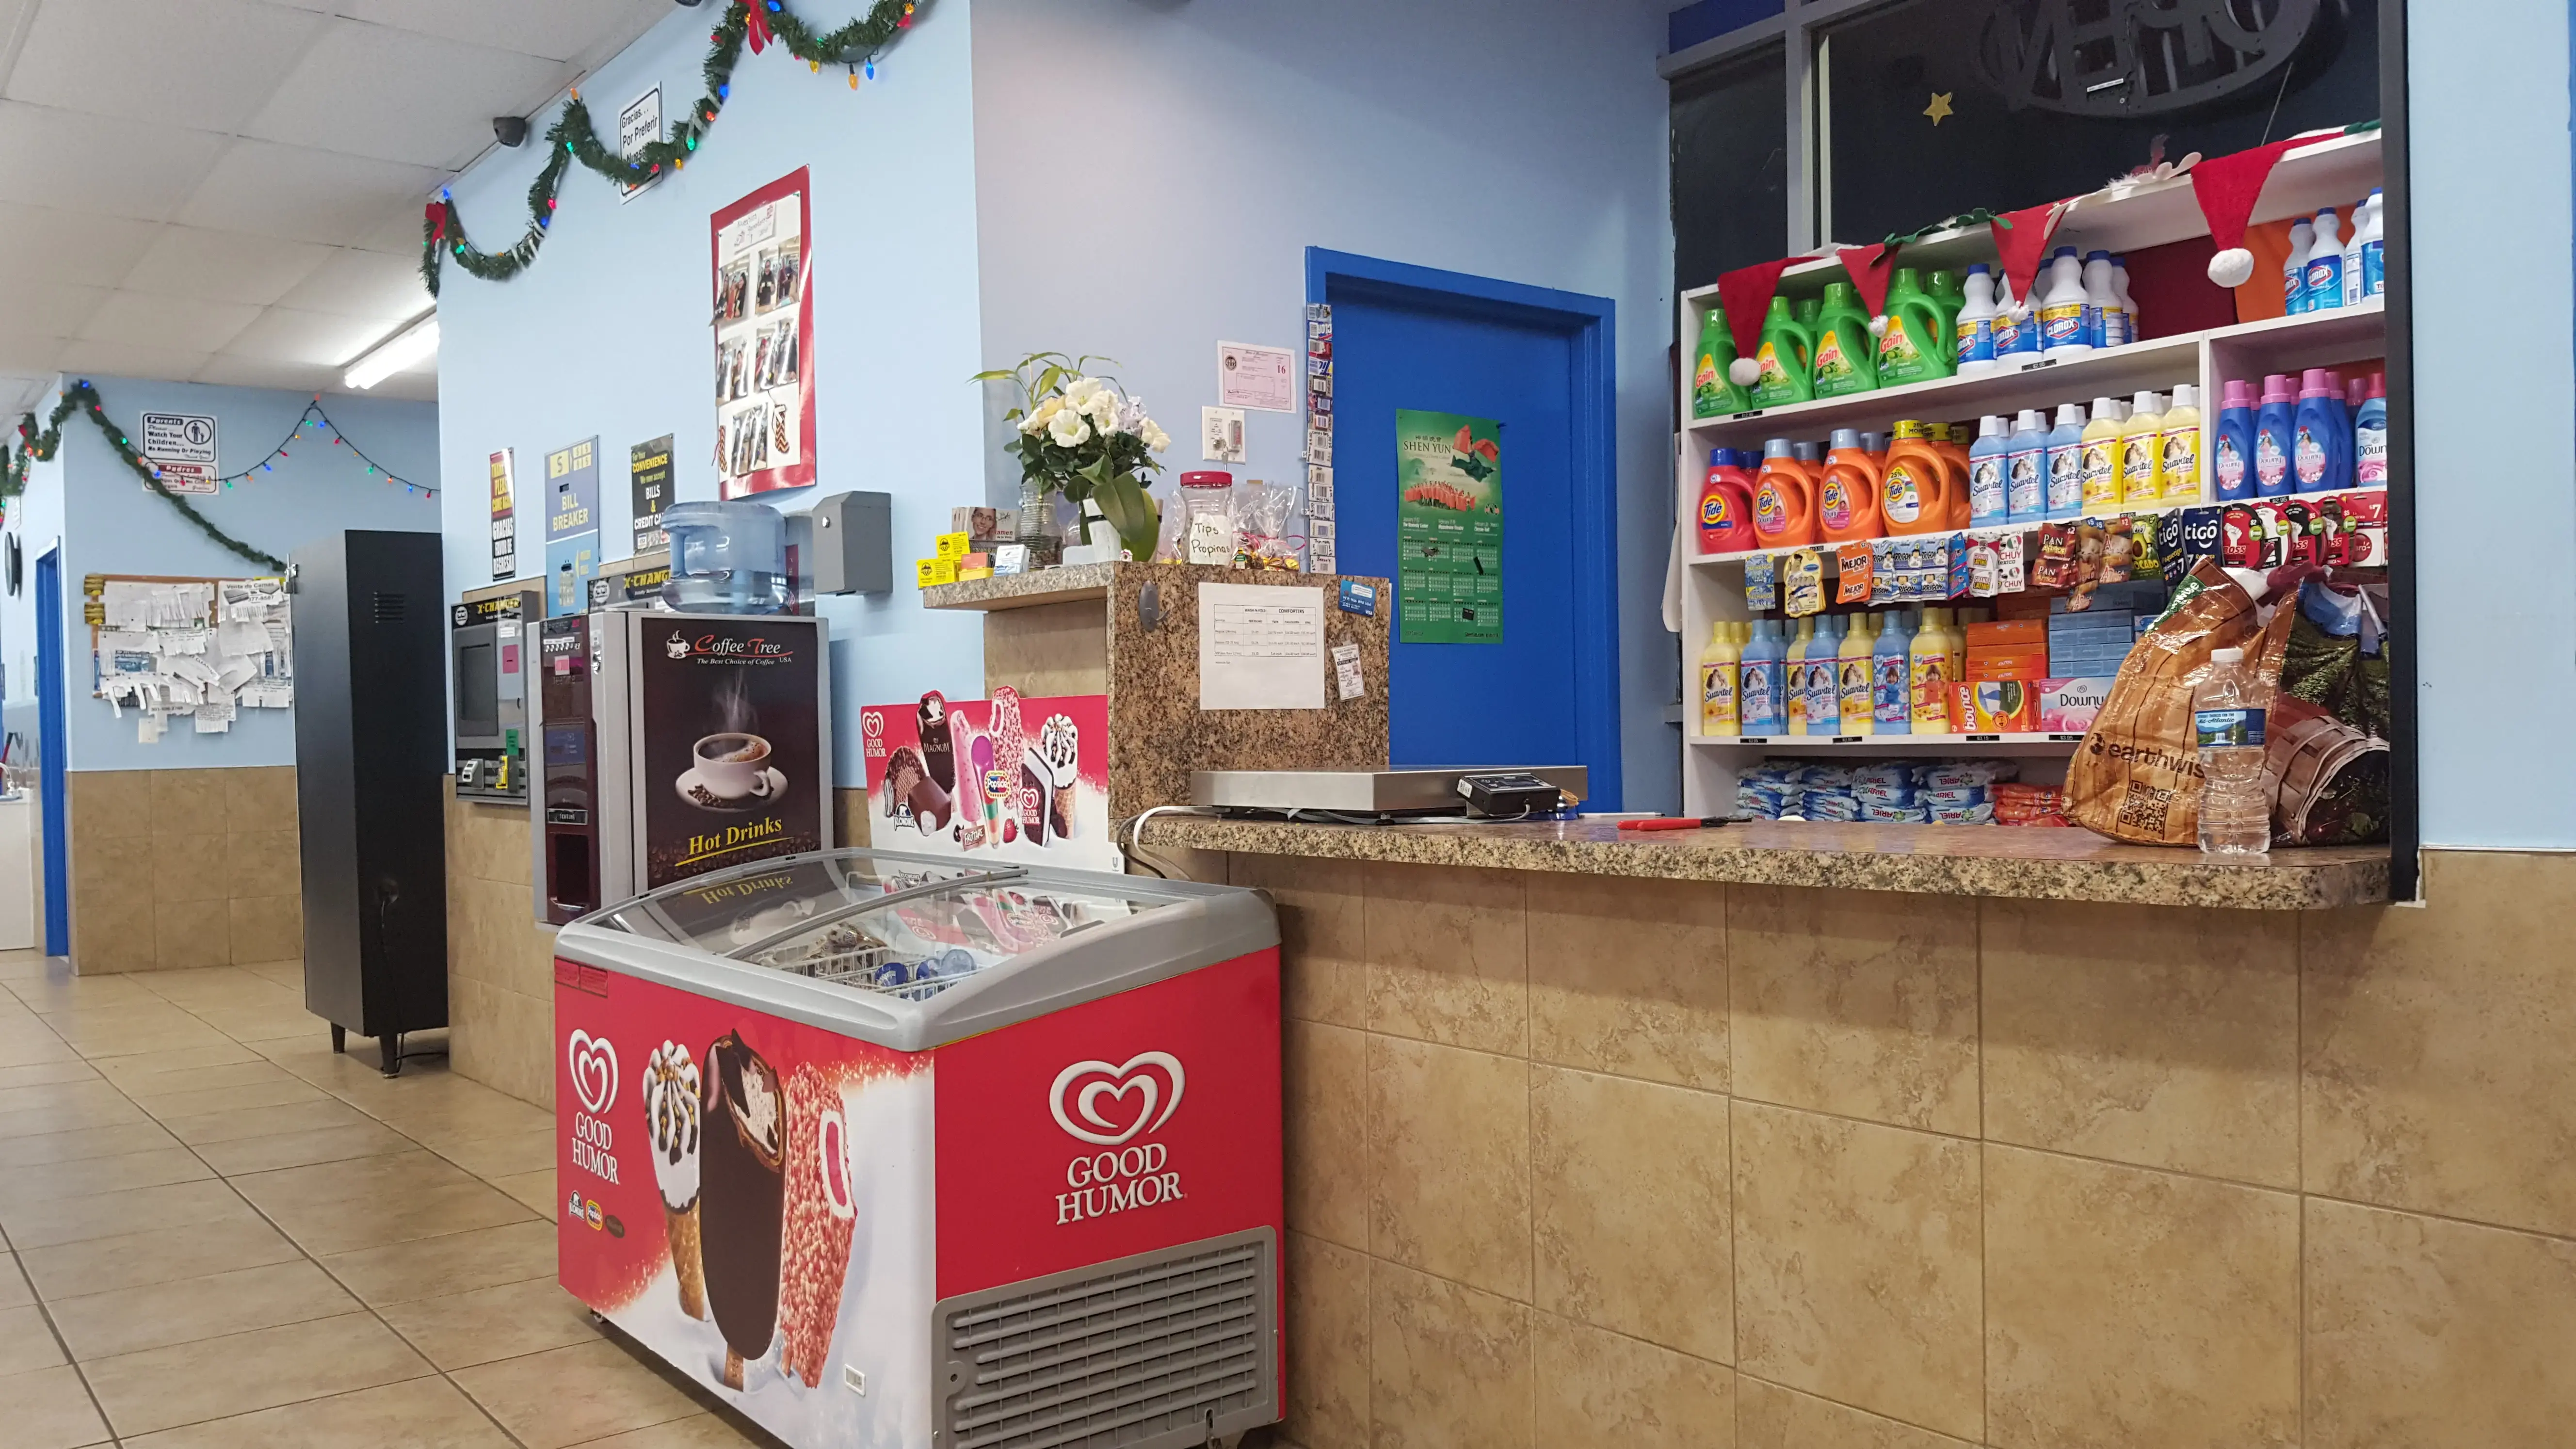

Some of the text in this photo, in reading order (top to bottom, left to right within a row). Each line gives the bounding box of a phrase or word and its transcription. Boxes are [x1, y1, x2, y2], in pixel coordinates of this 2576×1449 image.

[623, 115, 658, 149] Por Preferir
[2046, 318, 2076, 337] CLOROX
[1880, 334, 1903, 353] Gain
[1760, 359, 1775, 372] ain
[1817, 349, 1838, 368] Gain
[1277, 364, 1286, 375] 16
[1695, 370, 1714, 388] Gain
[1403, 441, 1451, 454] SHEN YUN
[632, 453, 668, 474] CONVENIENCE
[2162, 454, 2194, 473] Suavitel
[2297, 453, 2322, 462] Downy
[2082, 464, 2112, 483] Suavitel
[2123, 460, 2153, 478] Suavitel
[2010, 474, 2040, 493] Suavitel
[2050, 469, 2081, 488] Suavitel
[645, 484, 660, 500] BILLS
[1824, 489, 1838, 501] Tide
[1889, 485, 1902, 499] Tide
[1973, 479, 2003, 497] Suavitel
[562, 492, 579, 512] BILL
[650, 499, 656, 513] &
[1704, 501, 1723, 520] Tide
[1758, 496, 1773, 509] Tide
[2369, 503, 2382, 518] $7
[493, 516, 513, 541] GRACIAS
[552, 508, 589, 532] BREAKER
[634, 515, 653, 531] CREDIT
[1194, 523, 1219, 537] Tips
[507, 537, 513, 554] DE
[1191, 539, 1230, 558] Propinas
[2043, 534, 2063, 546] PAN
[1842, 556, 1868, 571] MEJOR
[2000, 551, 2022, 560] CHUY
[2037, 565, 2056, 577] PAN
[2134, 559, 2159, 570] OCADO
[1844, 583, 1864, 596] MEJOR
[694, 634, 781, 656] Coffee Tree
[1705, 686, 1733, 702] Suavitel
[1742, 684, 1771, 702] Suavitel
[1788, 688, 1805, 700] Suav
[1807, 684, 1837, 701] Suavitel
[1841, 682, 1870, 699] Suavitel
[1959, 686, 1977, 731] bounce
[2060, 693, 2104, 710] Downy
[866, 747, 887, 757] HUMOR
[867, 739, 883, 748] GOOD
[923, 742, 950, 753] MAGNUM
[2108, 741, 2206, 779] earthwis
[1868, 787, 1887, 797] ARIEL
[1872, 808, 1894, 818] ARIEL
[894, 816, 915, 828] KLONDIKE
[688, 816, 783, 856] Hot Drinks
[964, 828, 985, 844] FRUTTARE
[576, 1111, 612, 1151] GOOD
[572, 1137, 620, 1186] HUMOR
[1067, 1143, 1168, 1188] GOOD
[1056, 1171, 1185, 1226] HUMOR
